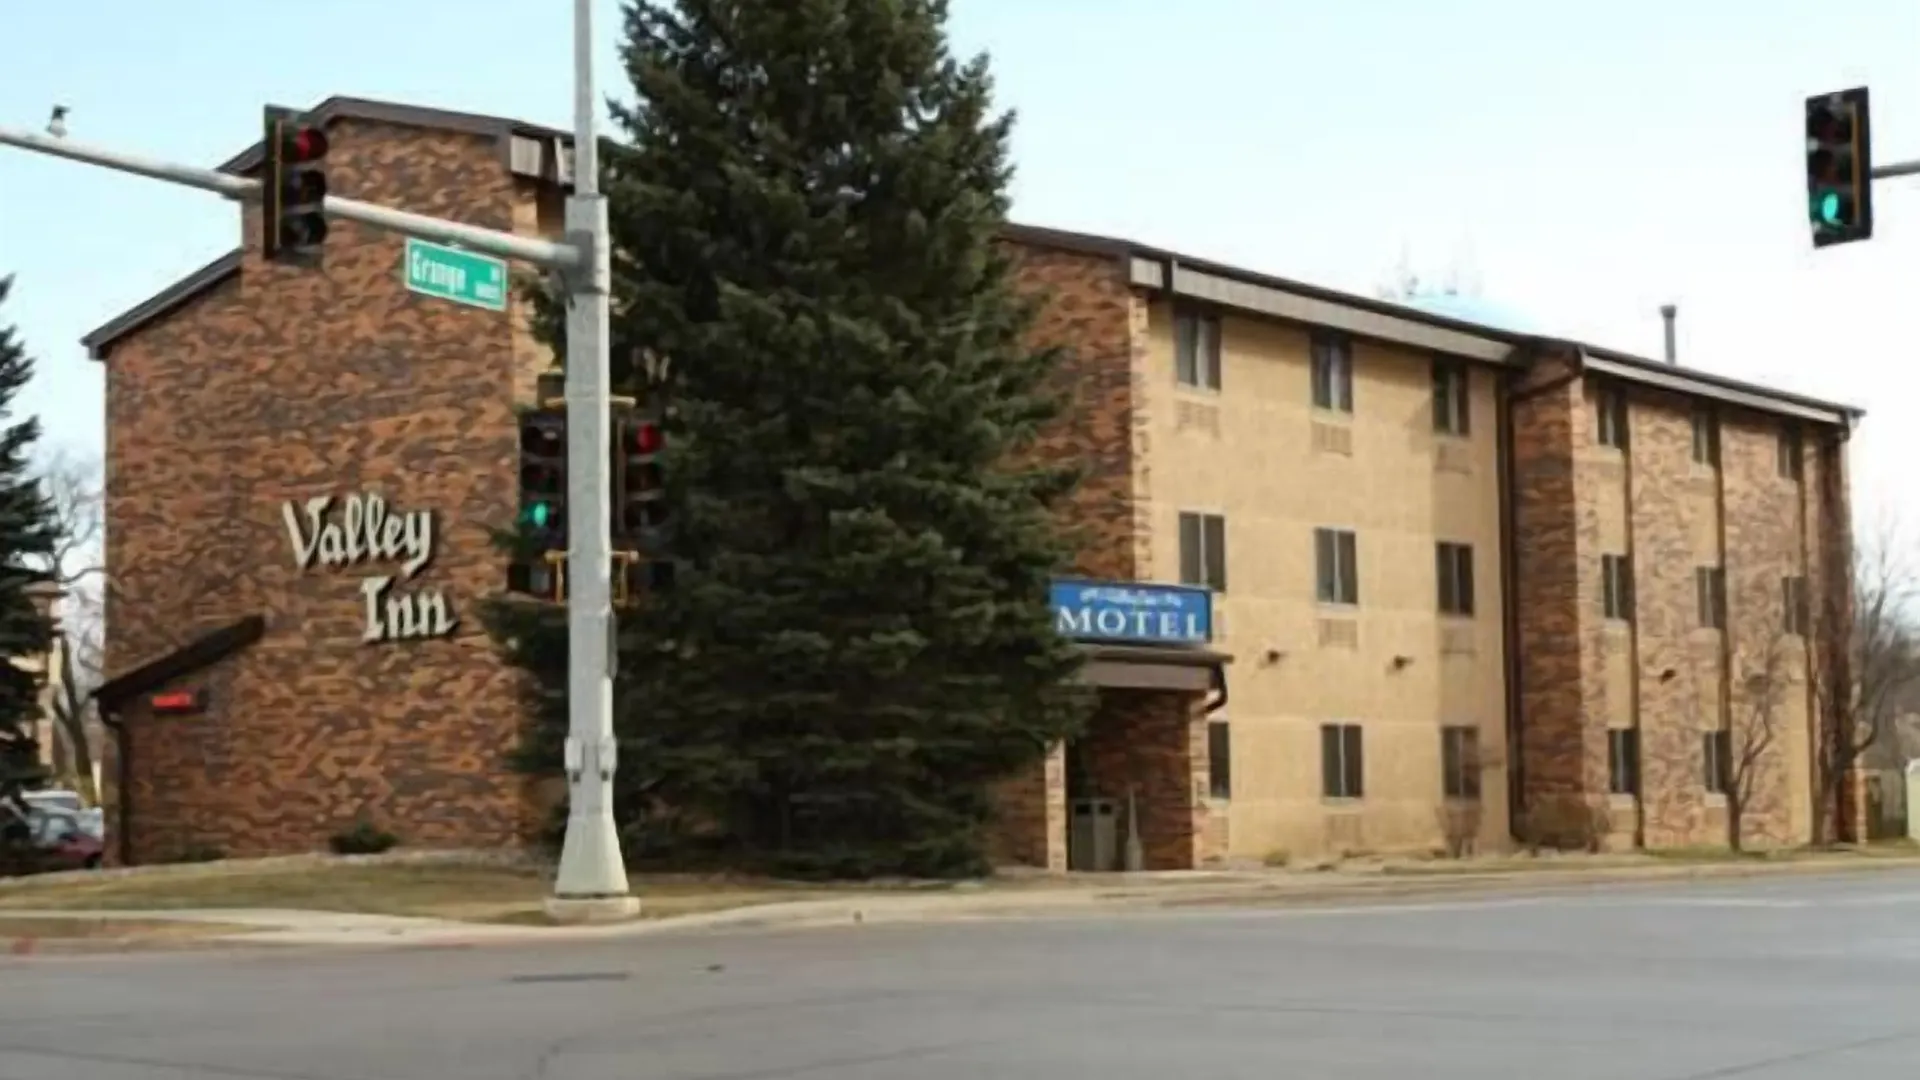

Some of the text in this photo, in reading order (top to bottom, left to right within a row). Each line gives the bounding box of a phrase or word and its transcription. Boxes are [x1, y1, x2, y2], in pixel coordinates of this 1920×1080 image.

[282, 493, 432, 577] Valley
[361, 576, 458, 640] Inn
[1057, 606, 1206, 640] MOTEL
